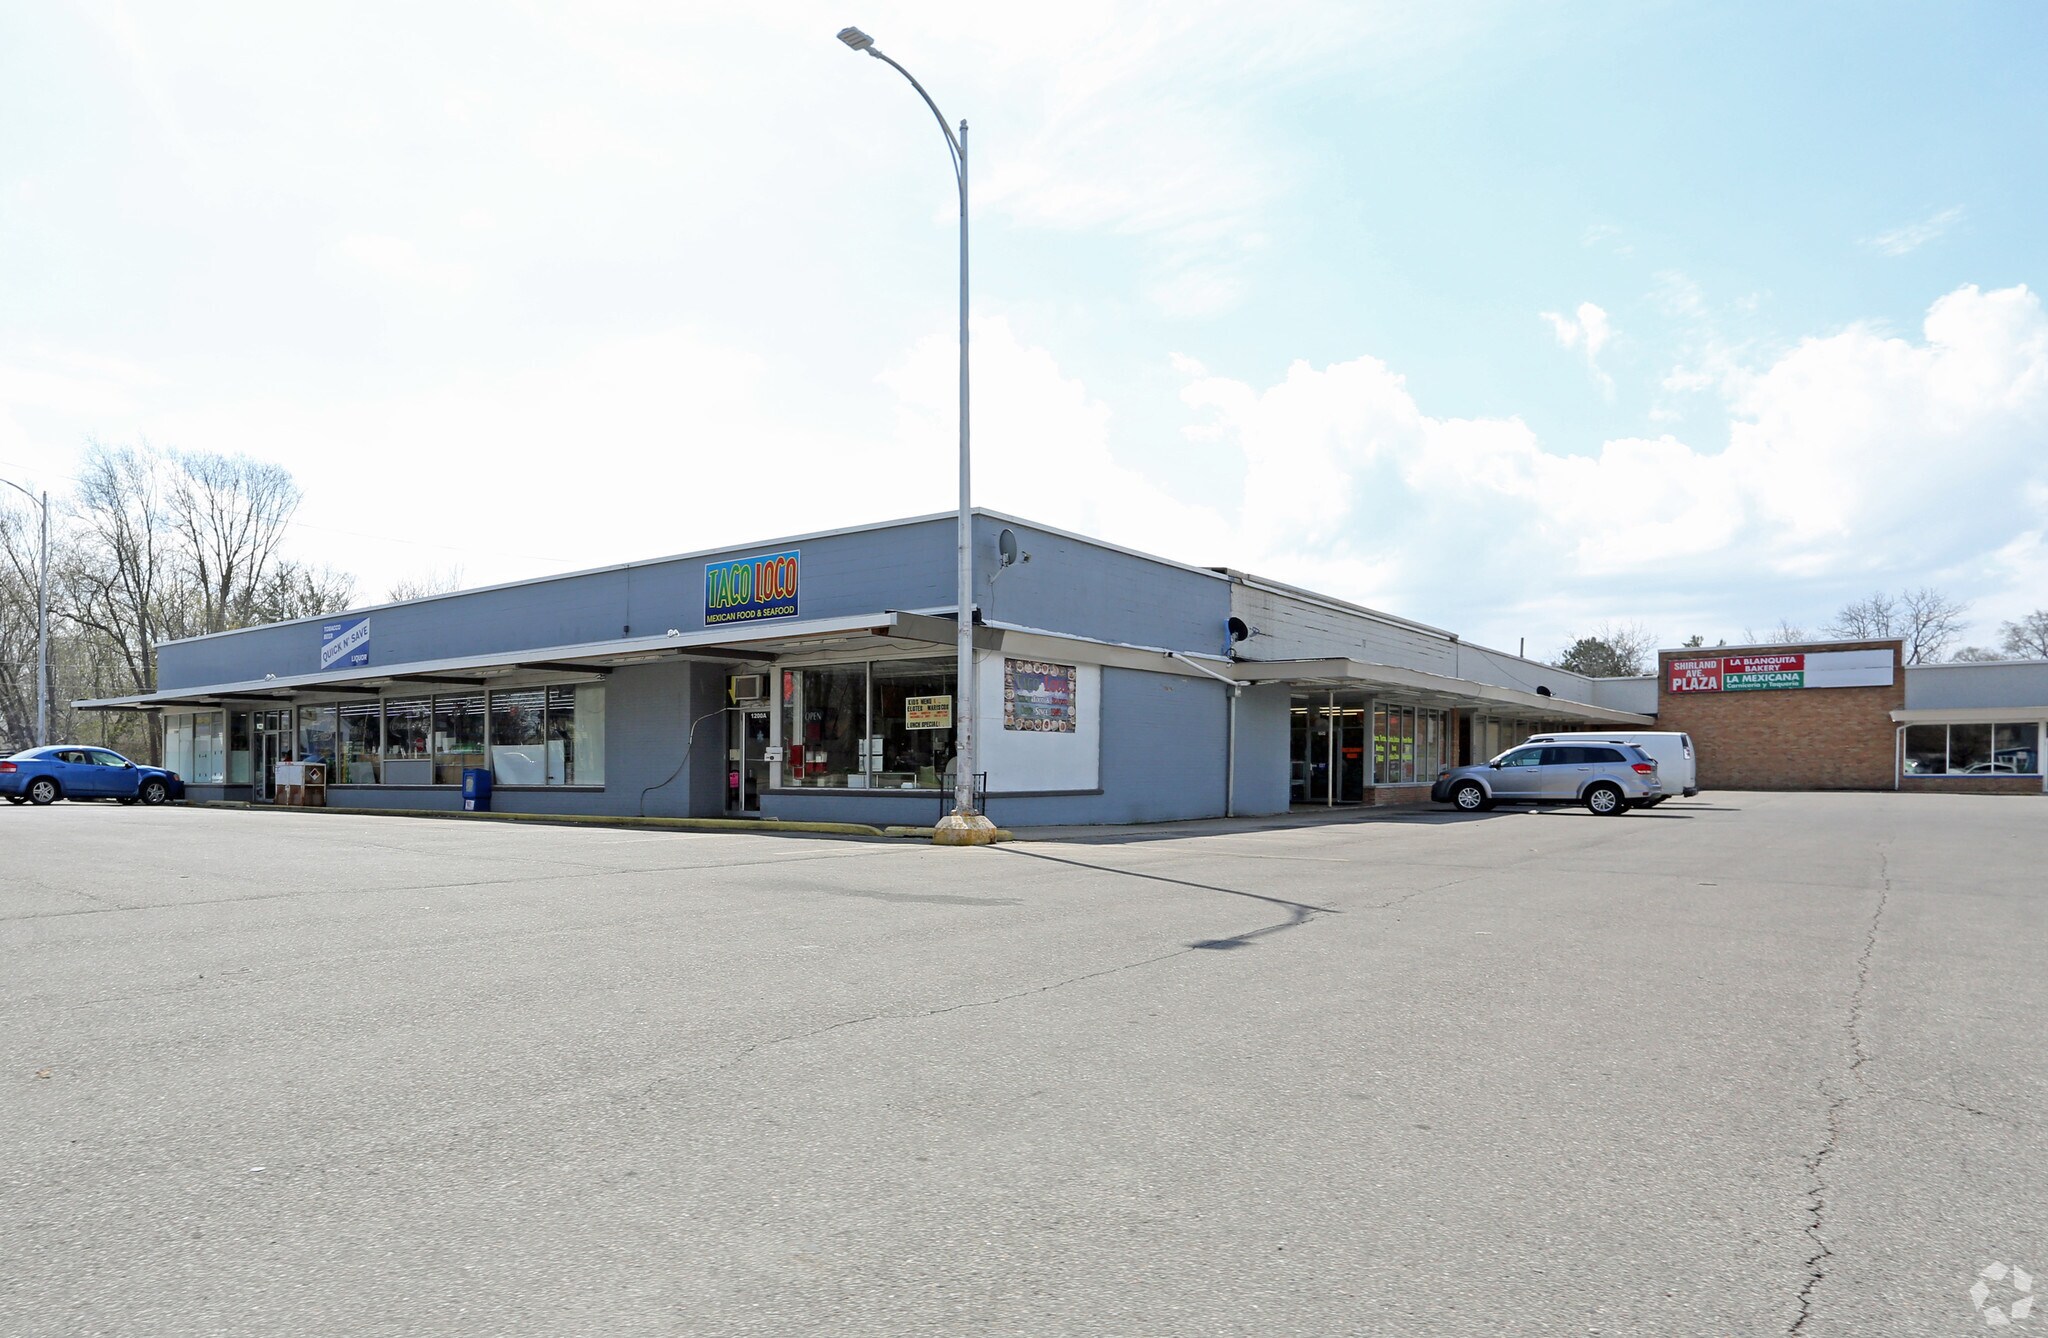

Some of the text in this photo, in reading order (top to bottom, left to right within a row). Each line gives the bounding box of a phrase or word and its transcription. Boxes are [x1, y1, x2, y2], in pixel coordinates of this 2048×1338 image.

[708, 556, 798, 608] TACO LOCO
[706, 605, 795, 623] MEXICAN FOOD & SEAFOOD
[323, 642, 342, 662] QUICK
[351, 626, 367, 643] SAVE
[351, 654, 367, 663] LIQUOR
[1743, 656, 1796, 665] BLANQUITA
[1674, 660, 1717, 670] SHIRLAND
[1686, 669, 1705, 678] AVE.
[1726, 673, 1800, 683] LA MEXICANA
[1673, 677, 1717, 690] PLAZA
[804, 711, 822, 721] OPEN
